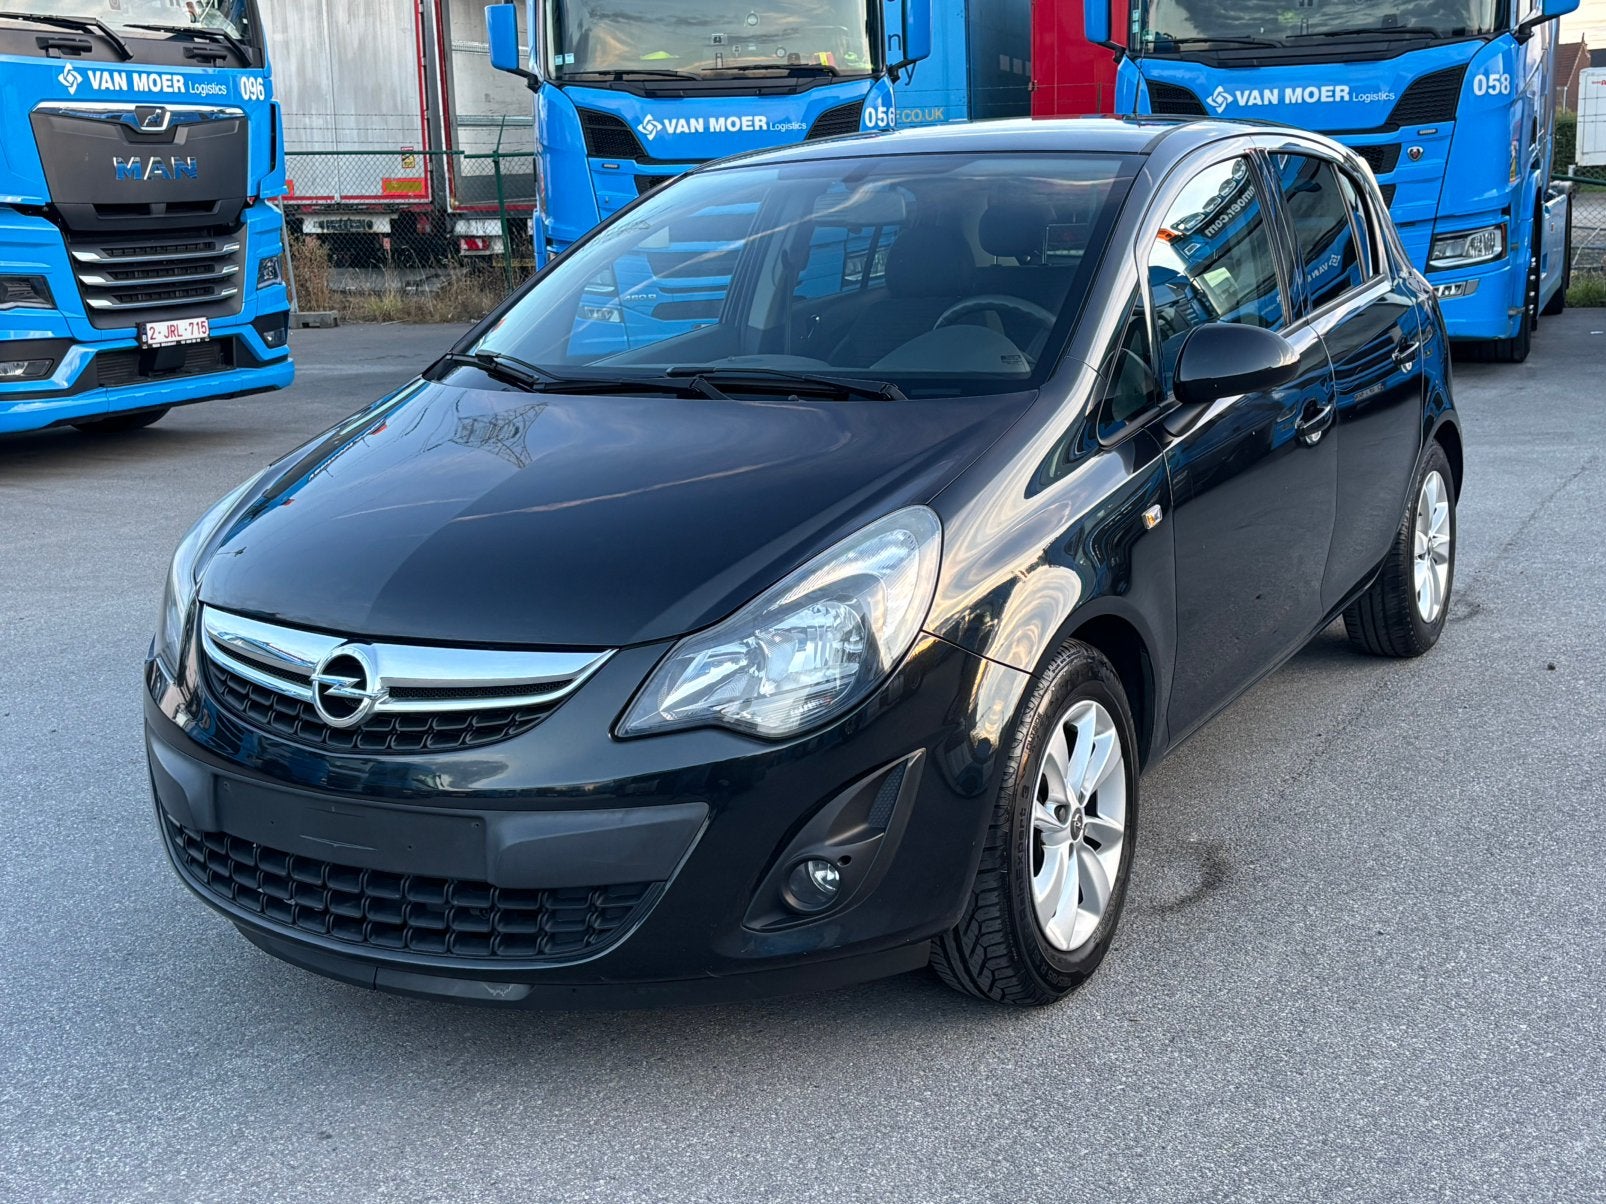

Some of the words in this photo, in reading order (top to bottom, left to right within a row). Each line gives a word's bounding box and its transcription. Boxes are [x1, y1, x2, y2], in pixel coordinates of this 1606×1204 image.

[88, 70, 128, 90] VAN
[132, 73, 185, 93] MOER
[188, 80, 227, 97] Logistics
[240, 76, 265, 100] 096
[1473, 74, 1510, 96] 058
[1235, 89, 1278, 106] VAN
[1285, 86, 1350, 104] MOER
[1353, 90, 1395, 103] Logistics
[664, 117, 705, 134] VAN
[709, 115, 768, 132] MOER
[769, 120, 807, 132] Logistics
[864, 106, 895, 128] 056
[113, 156, 199, 181] MAN
